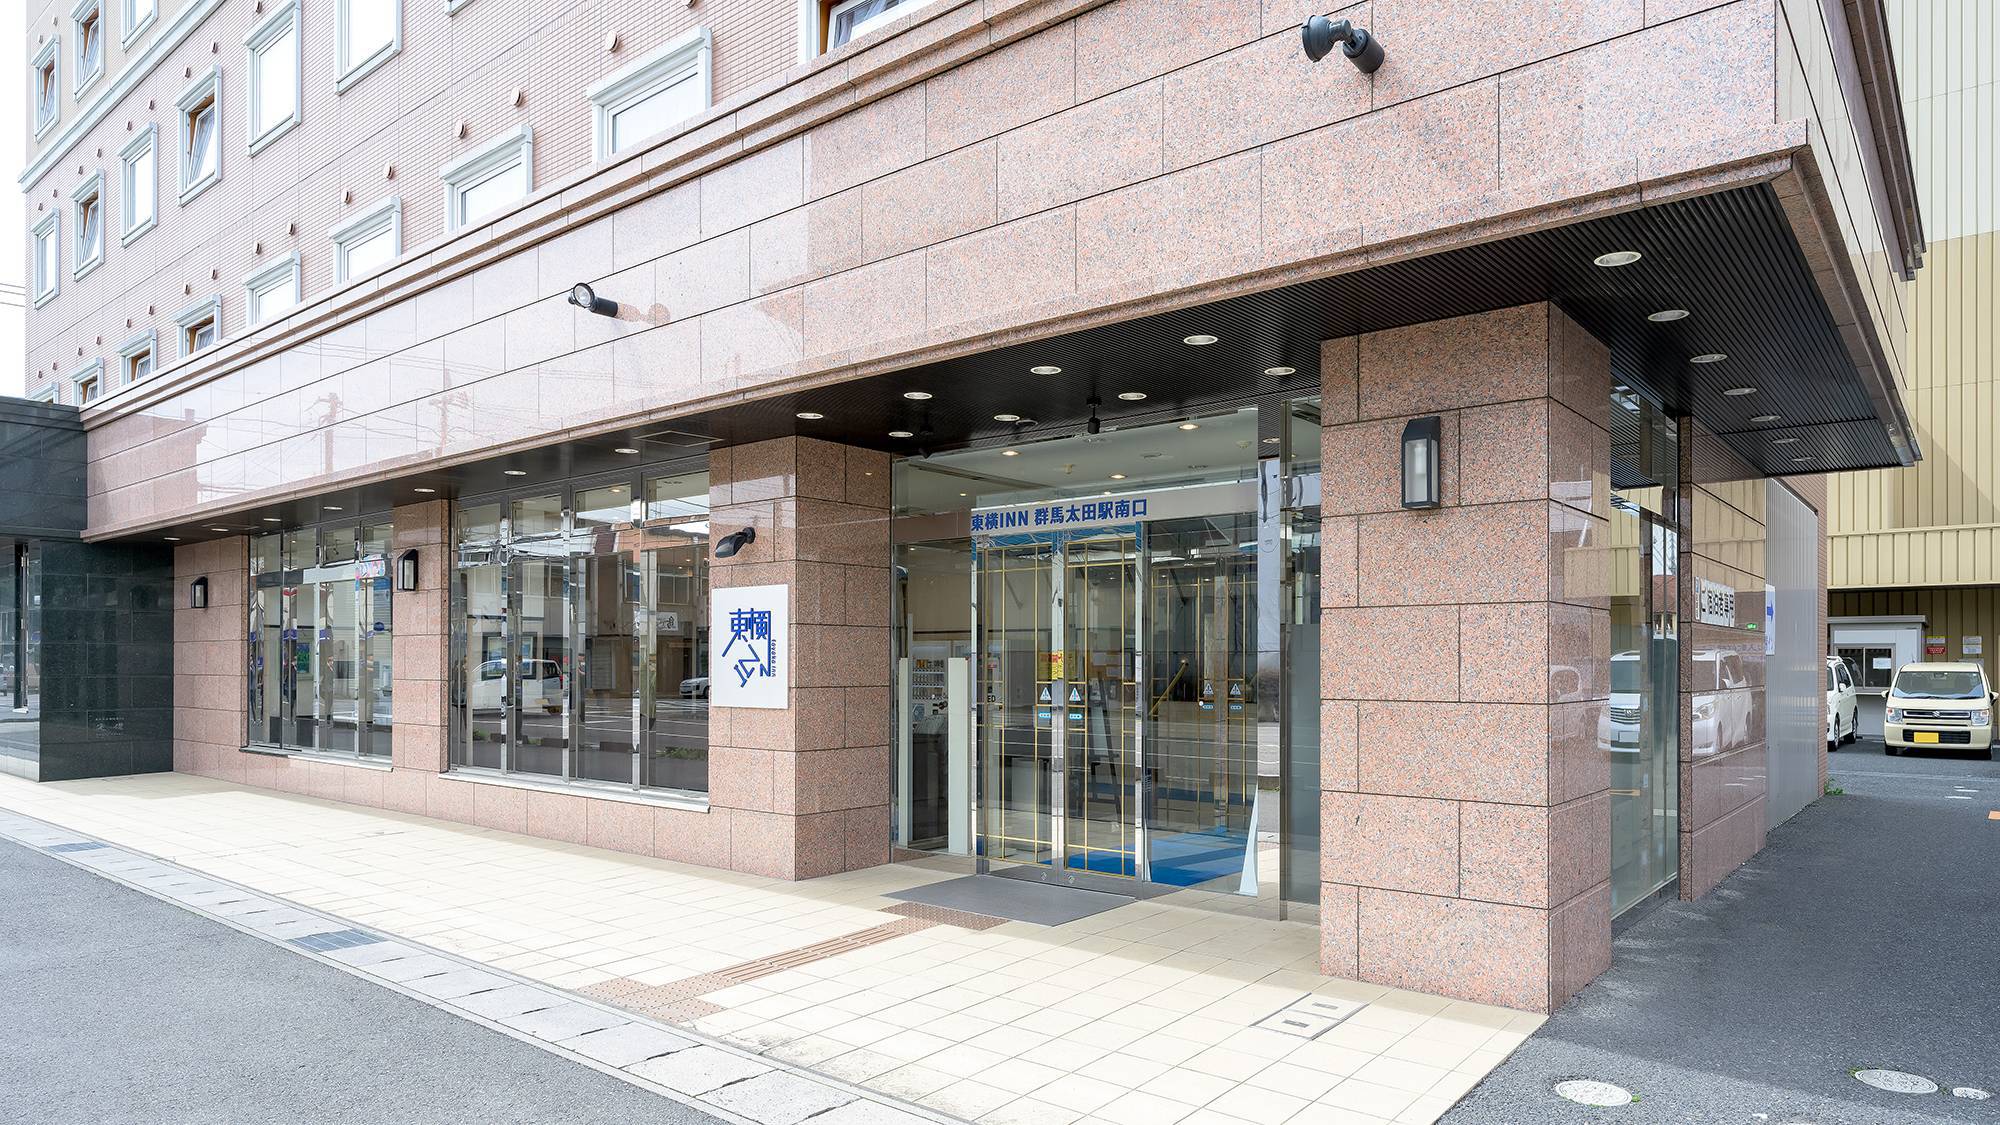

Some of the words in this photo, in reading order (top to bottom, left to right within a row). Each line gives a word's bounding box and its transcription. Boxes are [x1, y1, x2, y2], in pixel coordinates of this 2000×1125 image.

[971, 510, 1029, 532] 東横INN
[1034, 498, 1148, 526] 群馬太田駅南口
